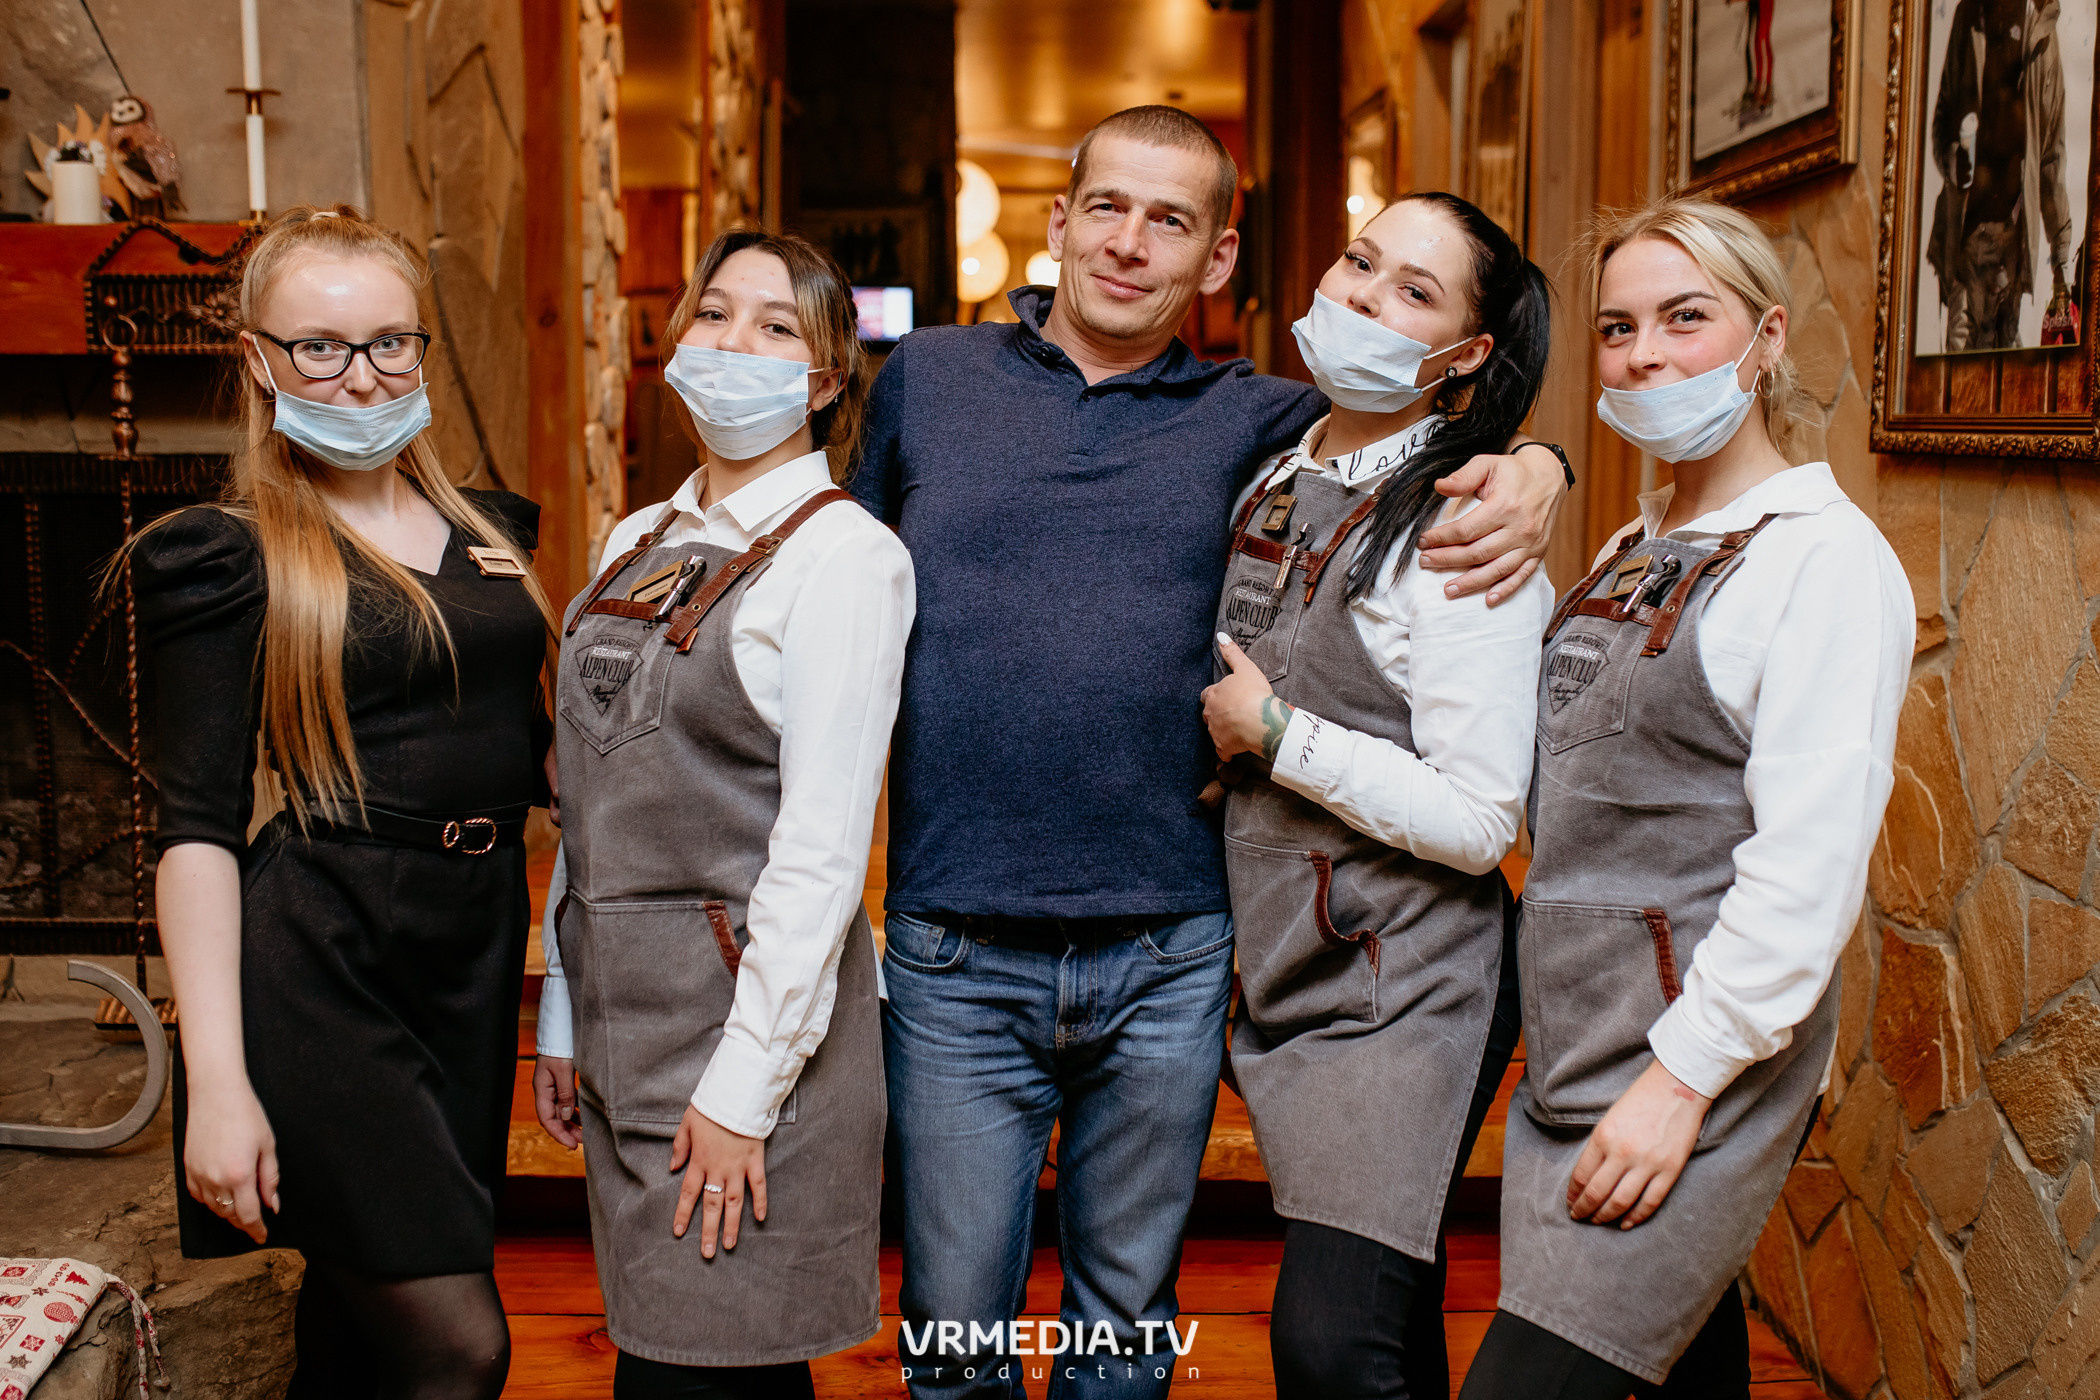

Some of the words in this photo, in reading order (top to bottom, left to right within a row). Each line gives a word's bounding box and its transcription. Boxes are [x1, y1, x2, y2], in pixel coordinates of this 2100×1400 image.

[2043, 314, 2073, 332] Splash
[1235, 588, 1271, 605] RESTAURANT
[591, 646, 632, 660] RESTAURANT
[1559, 644, 1599, 660] RESTAURANT
